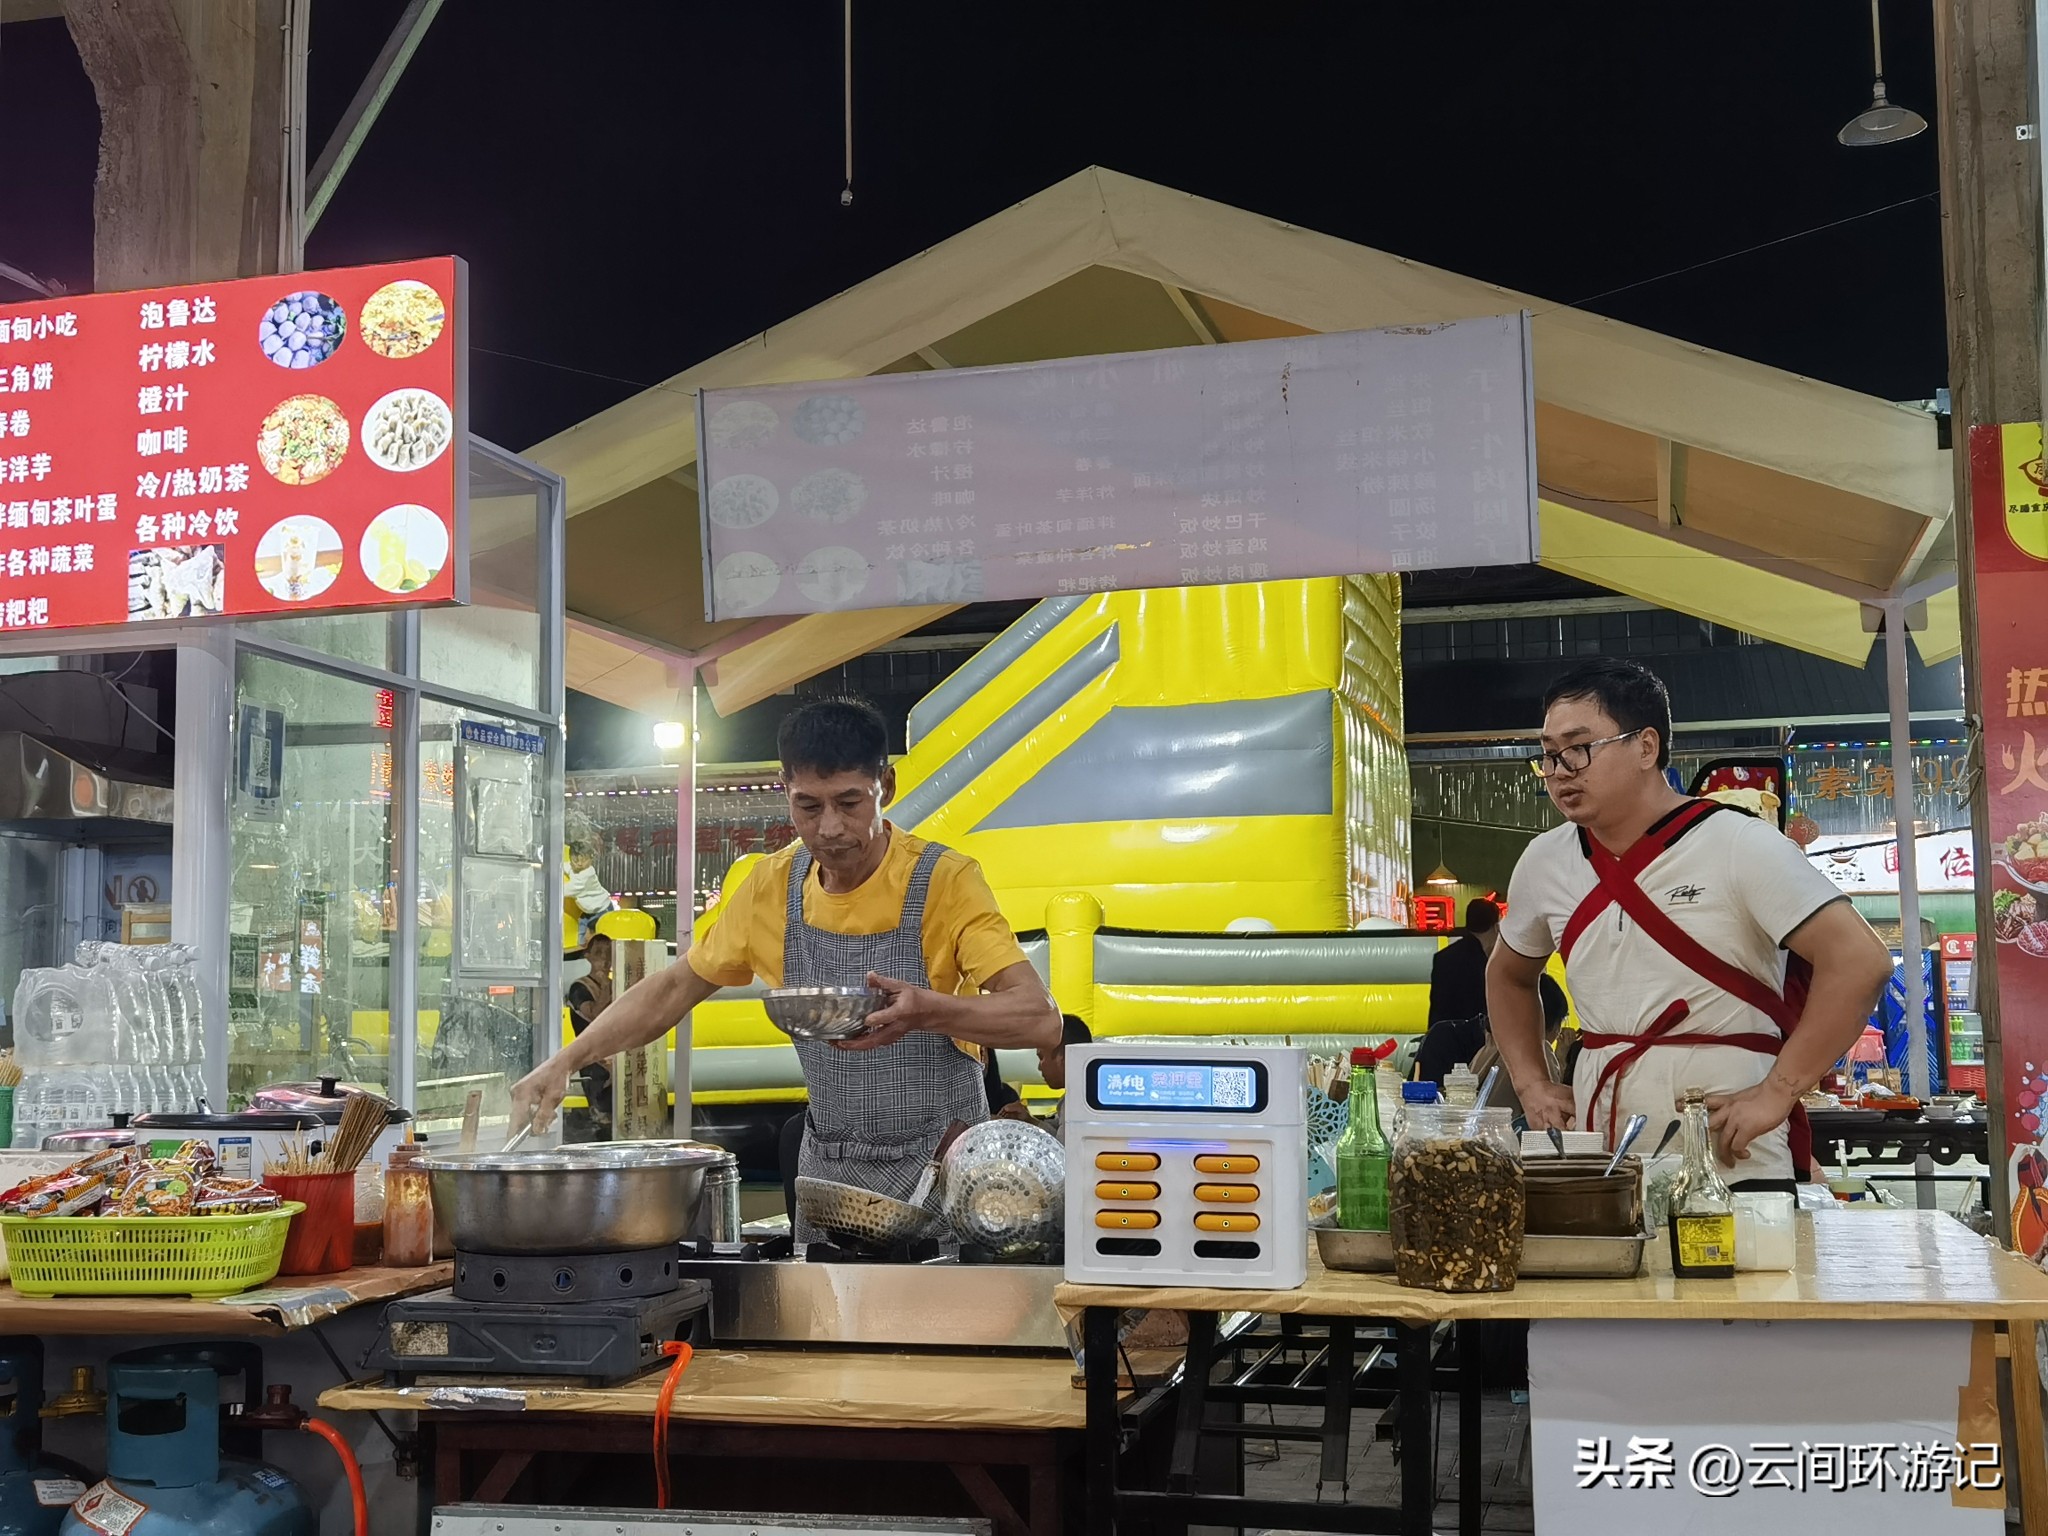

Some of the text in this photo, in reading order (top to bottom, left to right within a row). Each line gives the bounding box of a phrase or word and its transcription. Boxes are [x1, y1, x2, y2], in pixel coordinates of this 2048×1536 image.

[139, 296, 217, 329] 泡鲁达
[139, 339, 216, 372] 柠檬水
[138, 384, 189, 414] 橙汁
[137, 426, 188, 457] 咖啡
[136, 463, 249, 499] 冷/热奶茶
[135, 507, 239, 543] 各种冷饮
[0, 597, 49, 629] 粑粑
